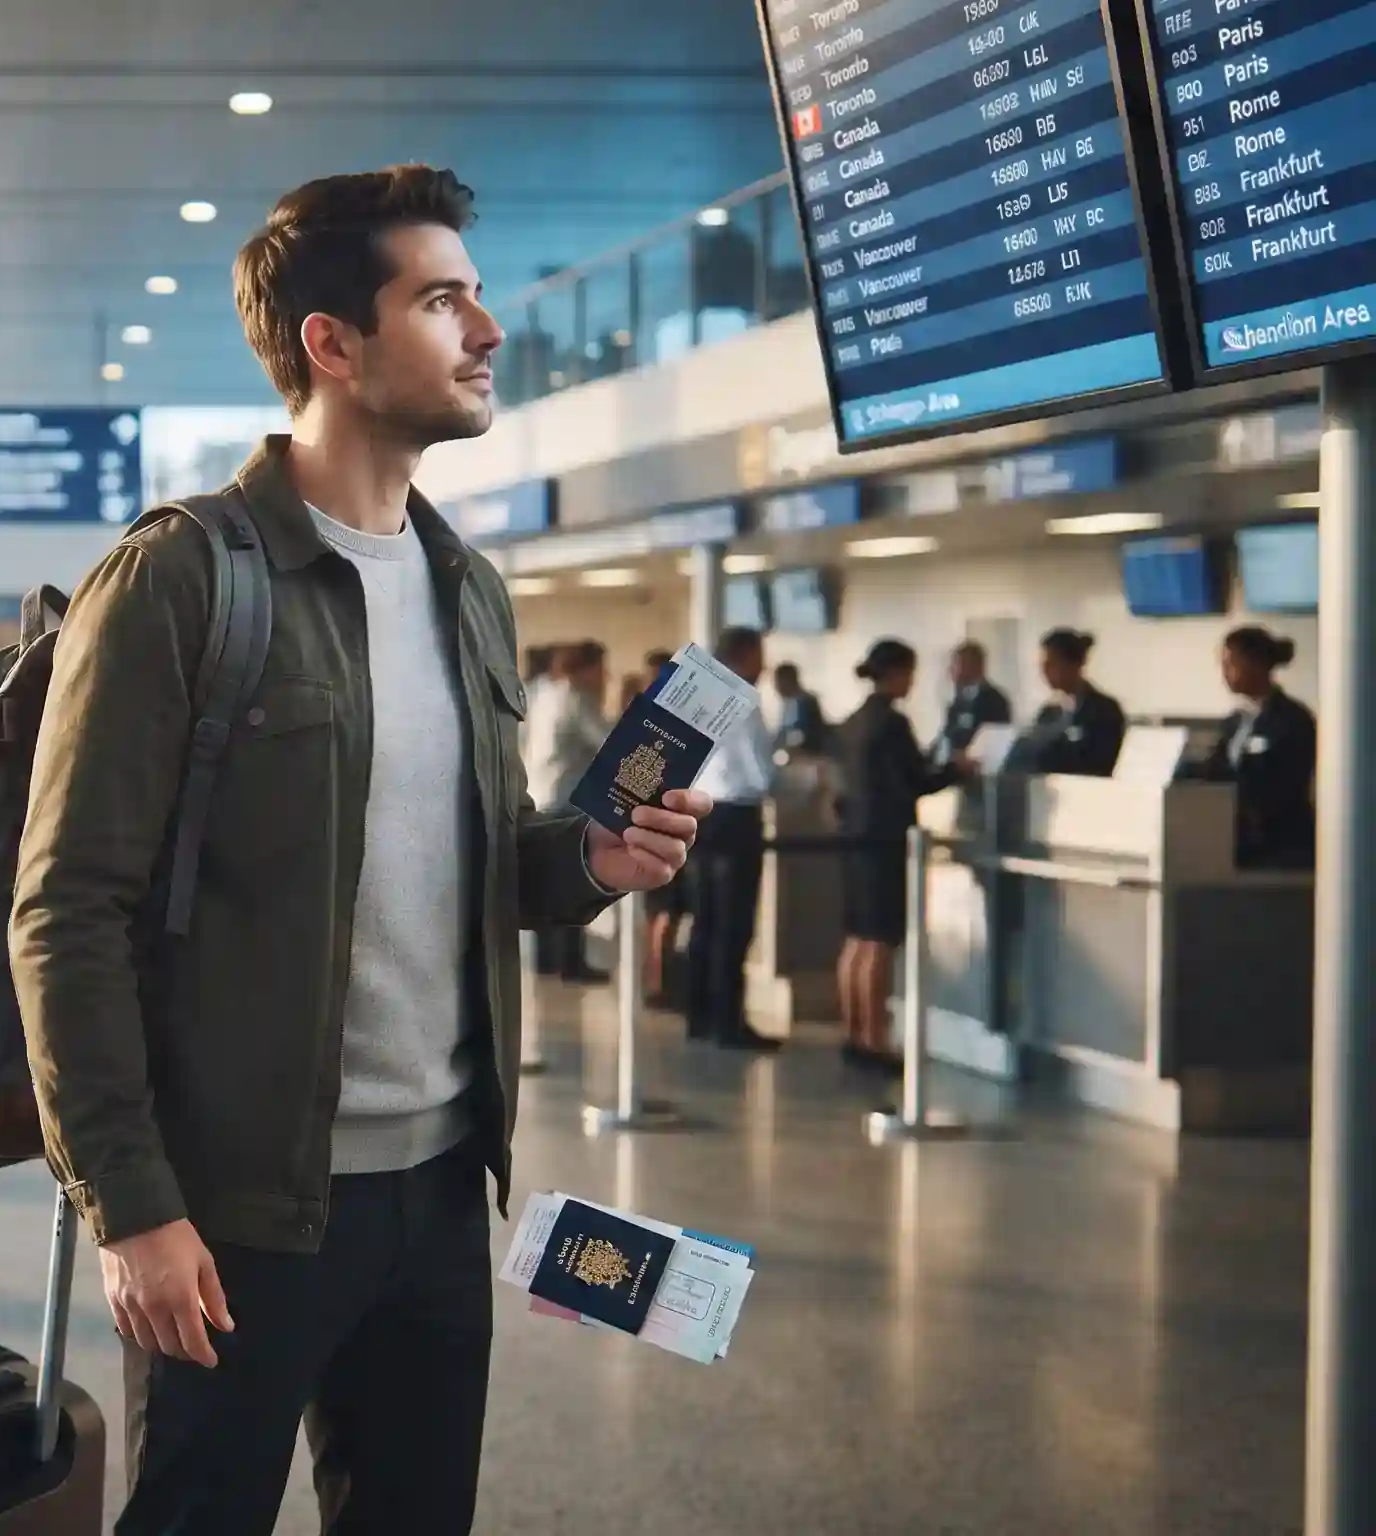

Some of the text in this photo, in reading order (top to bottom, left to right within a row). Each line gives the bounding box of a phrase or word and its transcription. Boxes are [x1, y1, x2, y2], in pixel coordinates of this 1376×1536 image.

[1218, 17, 1264, 50] Paris
[820, 54, 869, 89] Toronto
[1224, 53, 1269, 87] Paris
[826, 88, 876, 119] Toronto
[1229, 89, 1281, 123] Rome
[834, 117, 881, 149] Canada
[1235, 126, 1286, 158] Rome
[839, 147, 884, 178] Canada
[1239, 148, 1324, 192] Frankfurt
[844, 178, 890, 208] Canada
[1245, 184, 1330, 228] Frankfurt
[849, 209, 895, 237] Canada
[853, 235, 918, 269] Vancouver
[1251, 221, 1337, 262] Frankfurt
[858, 265, 923, 298] Vancouver
[1323, 304, 1371, 332] Area
